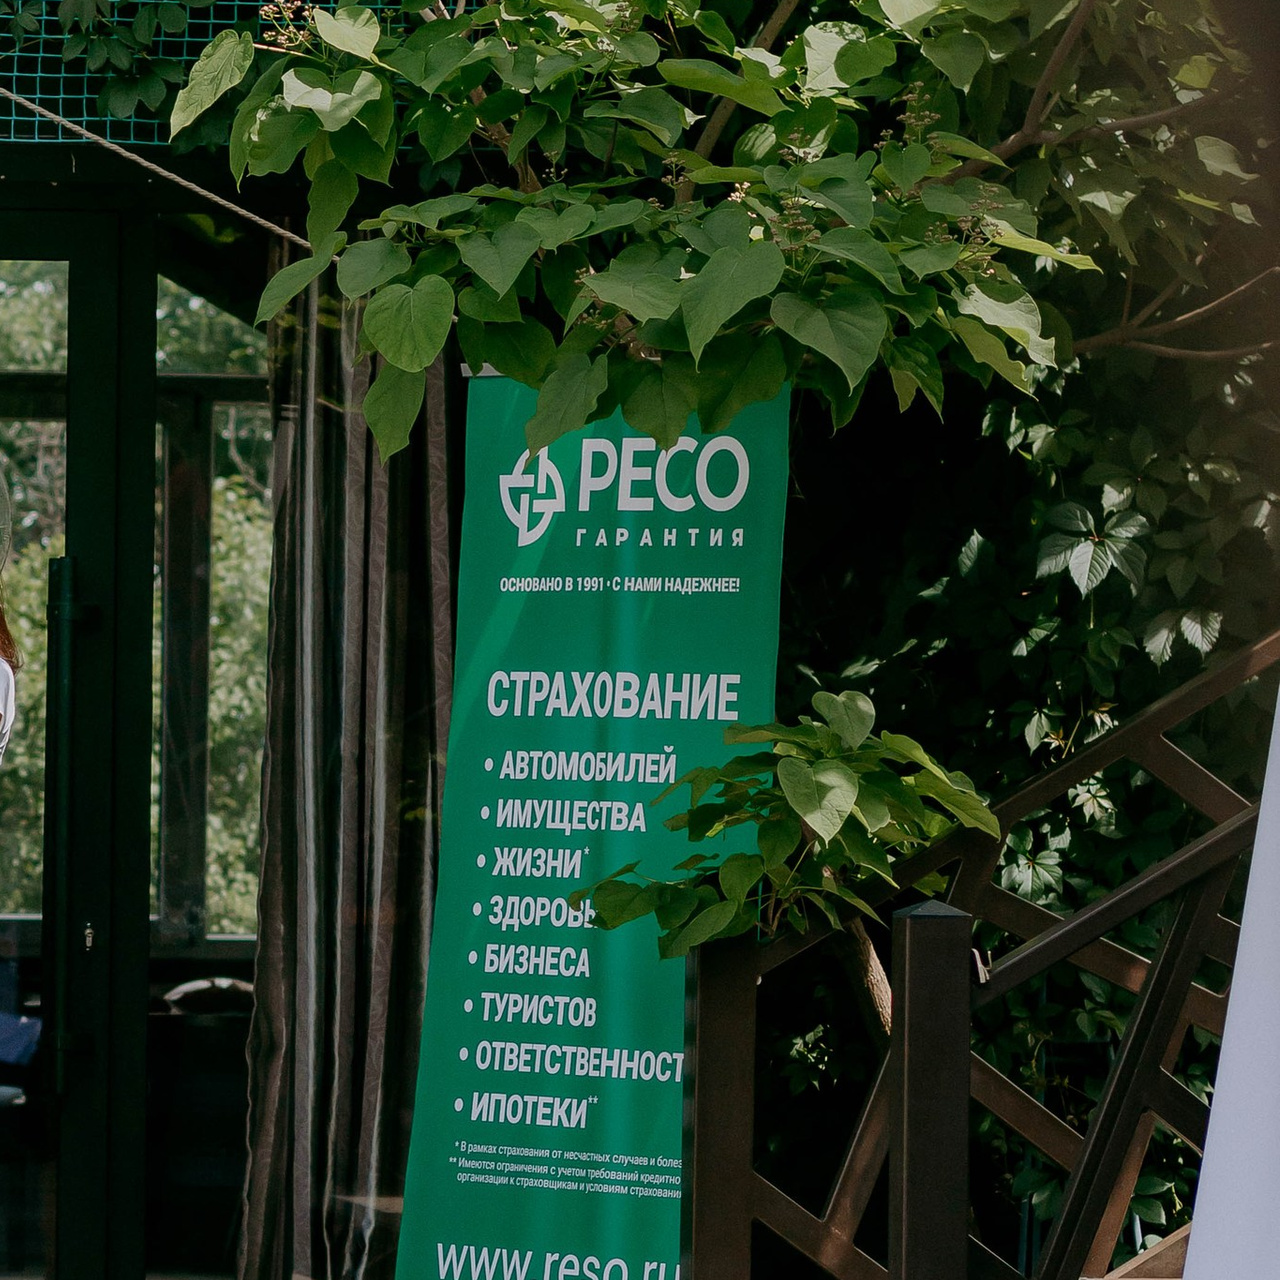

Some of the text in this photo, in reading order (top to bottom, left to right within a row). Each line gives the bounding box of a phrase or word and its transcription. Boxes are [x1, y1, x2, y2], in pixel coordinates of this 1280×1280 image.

[578, 435, 750, 513] РЕСО
[576, 528, 744, 547] ГАРАНТИЯ
[500, 577, 740, 594] ОСНОВАНО В 1991 С НАМИ НАДЕЖНЕЕ!
[487, 670, 741, 720] СТРАХОВАНИЕ
[499, 746, 677, 784] АВТОМОБИЛЕЙ
[496, 799, 647, 836] ИМУЩЕСТВА
[489, 895, 598, 931] ЗДОРОВЬ
[483, 945, 590, 978] БИЗНЕСА
[481, 992, 597, 1028] ТУРИСТОВ
[475, 1041, 684, 1083] ОТВЕТСТВЕННОСТ
[459, 1157, 681, 1185] Имеются ограничения с учетом требований кредитно
[461, 1141, 466, 1152] В
[468, 1144, 497, 1154] рамках
[498, 1146, 549, 1158] страхования
[552, 1149, 562, 1159] от
[564, 1151, 610, 1162] несчастных
[613, 1154, 648, 1166] случаев
[657, 1156, 682, 1168] болез
[457, 1173, 508, 1186] организации
[510, 1177, 515, 1185] к
[516, 1177, 578, 1191] страховщикам
[586, 1182, 627, 1194] условиям
